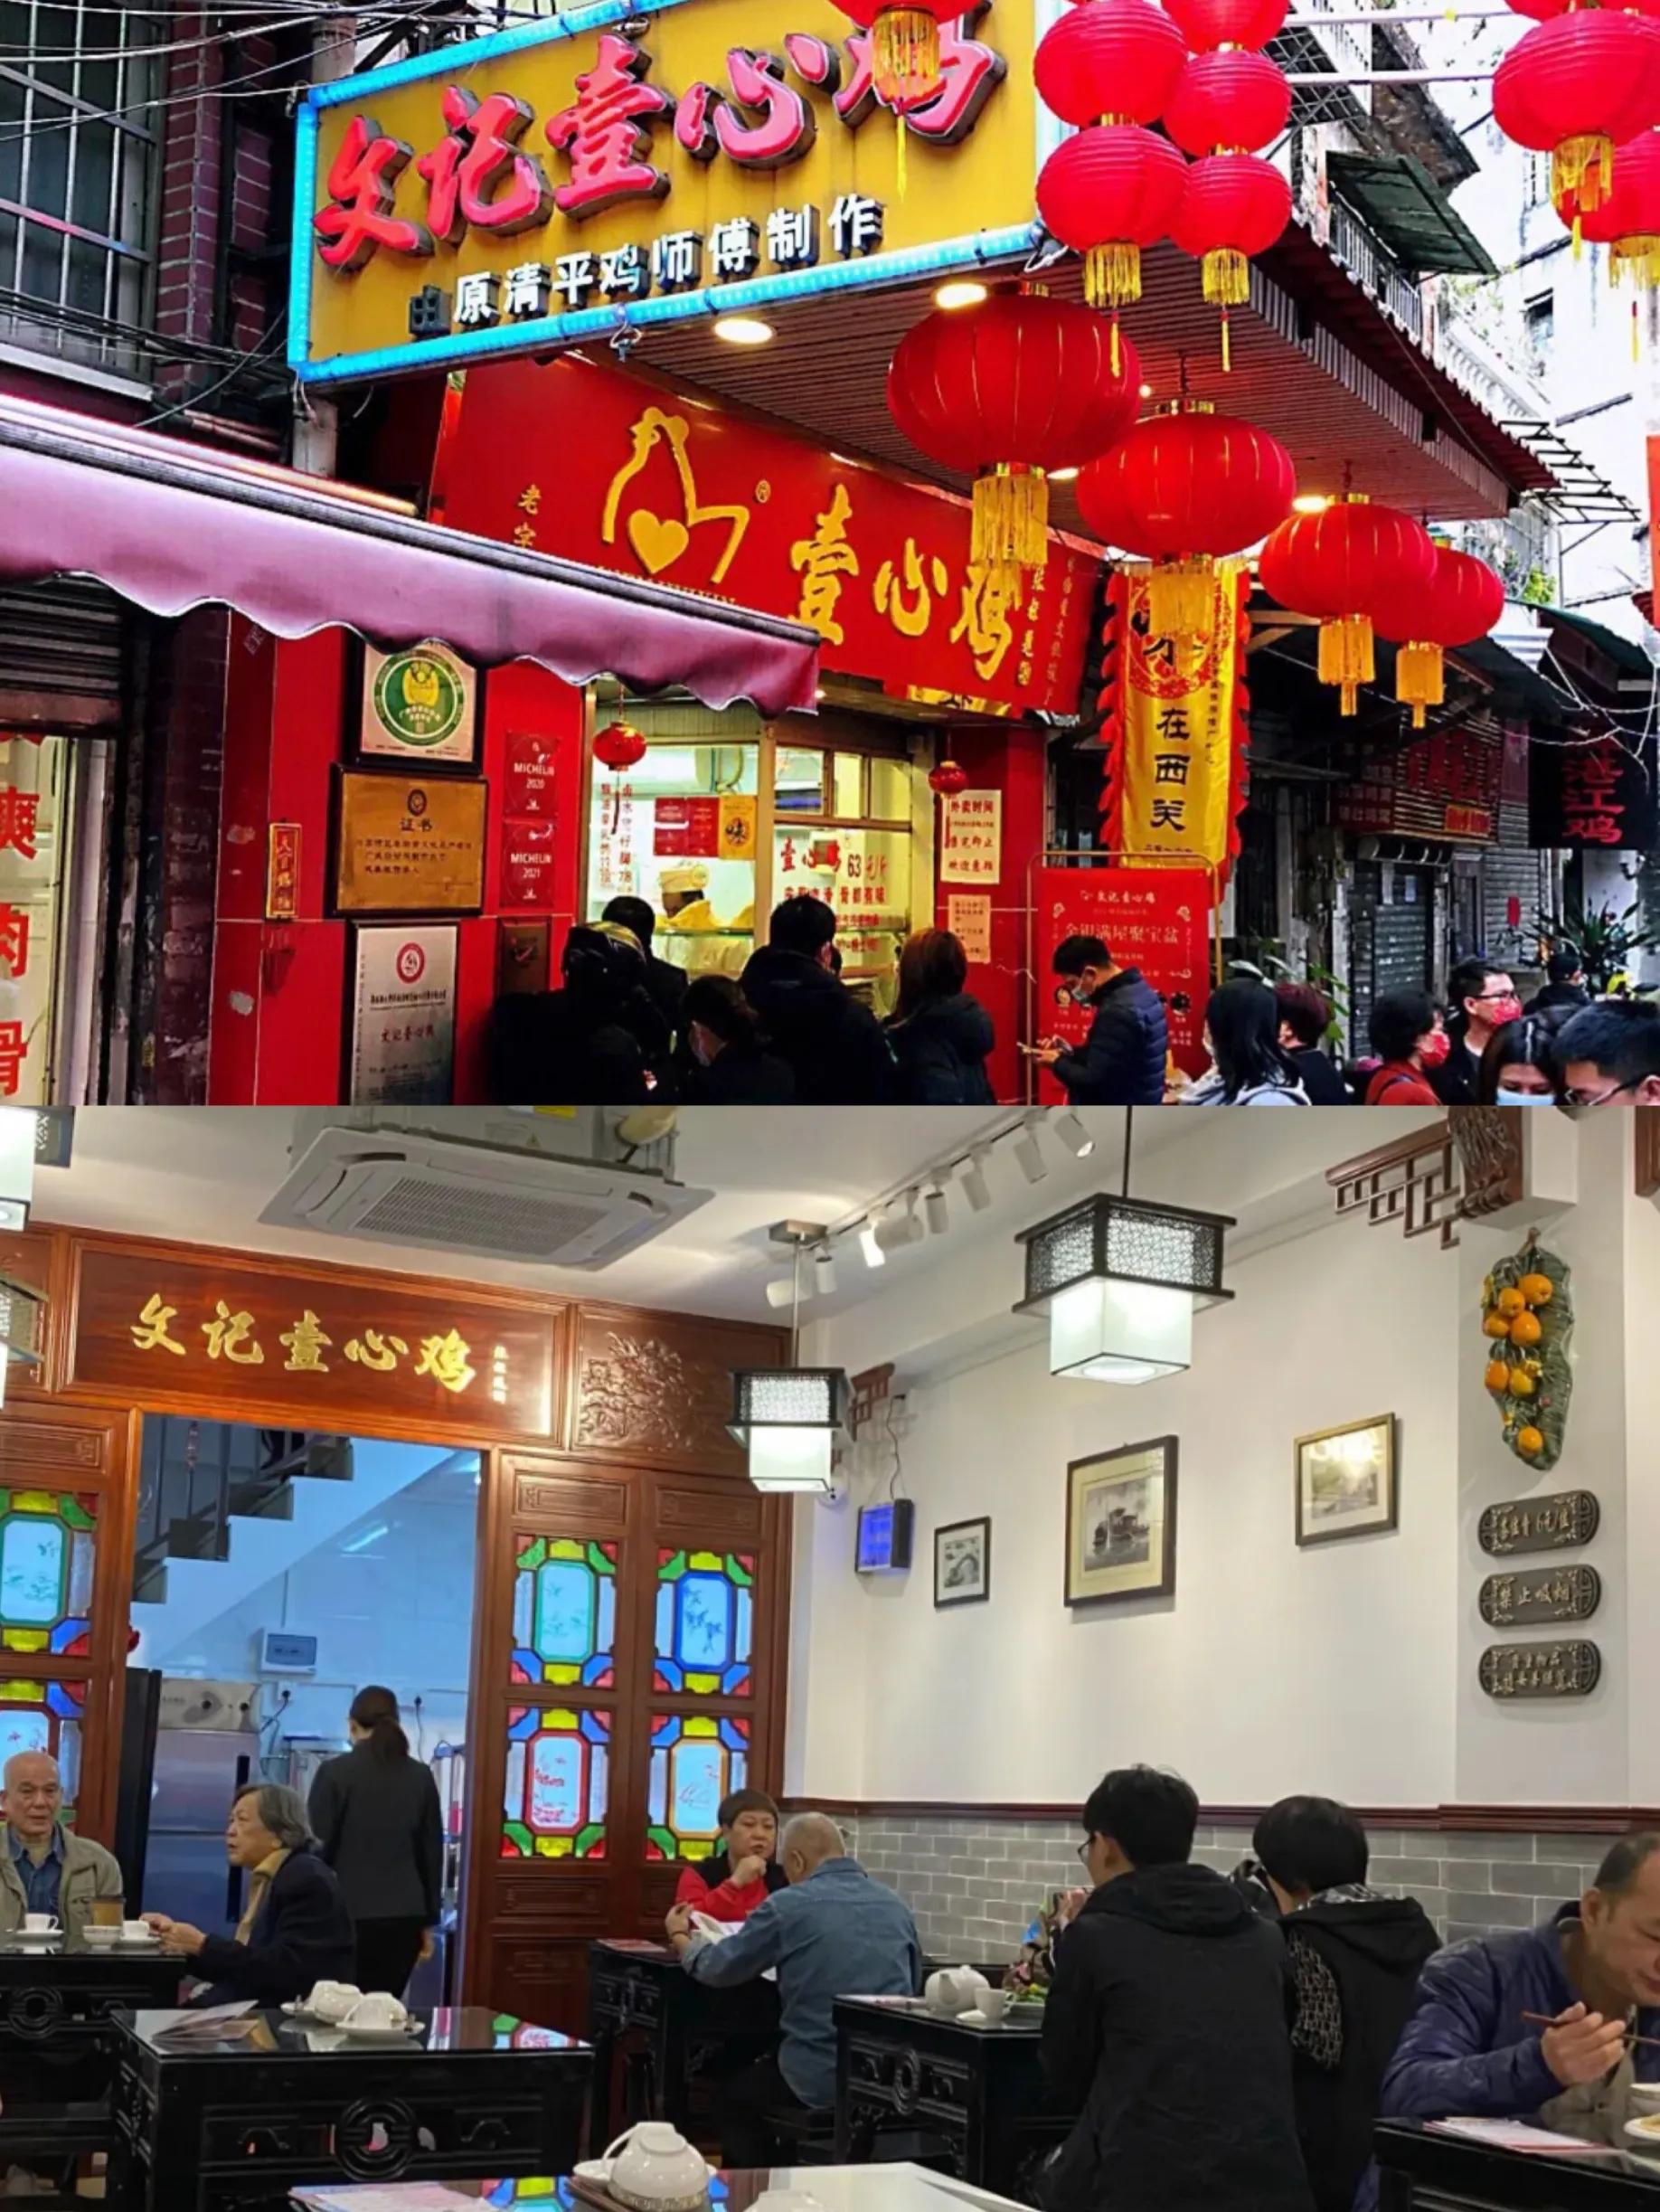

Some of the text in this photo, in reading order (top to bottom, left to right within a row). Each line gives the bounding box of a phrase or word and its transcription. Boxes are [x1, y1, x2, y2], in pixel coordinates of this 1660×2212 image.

[788, 484, 1012, 681] 壹心鸡
[514, 762, 554, 776] MICHELIN
[400, 818, 432, 832] 证书
[511, 853, 552, 864] MICHELIN
[129, 1293, 476, 1393] 文记壹心鸡
[1500, 1582, 1570, 1609] 禁止吸烟
